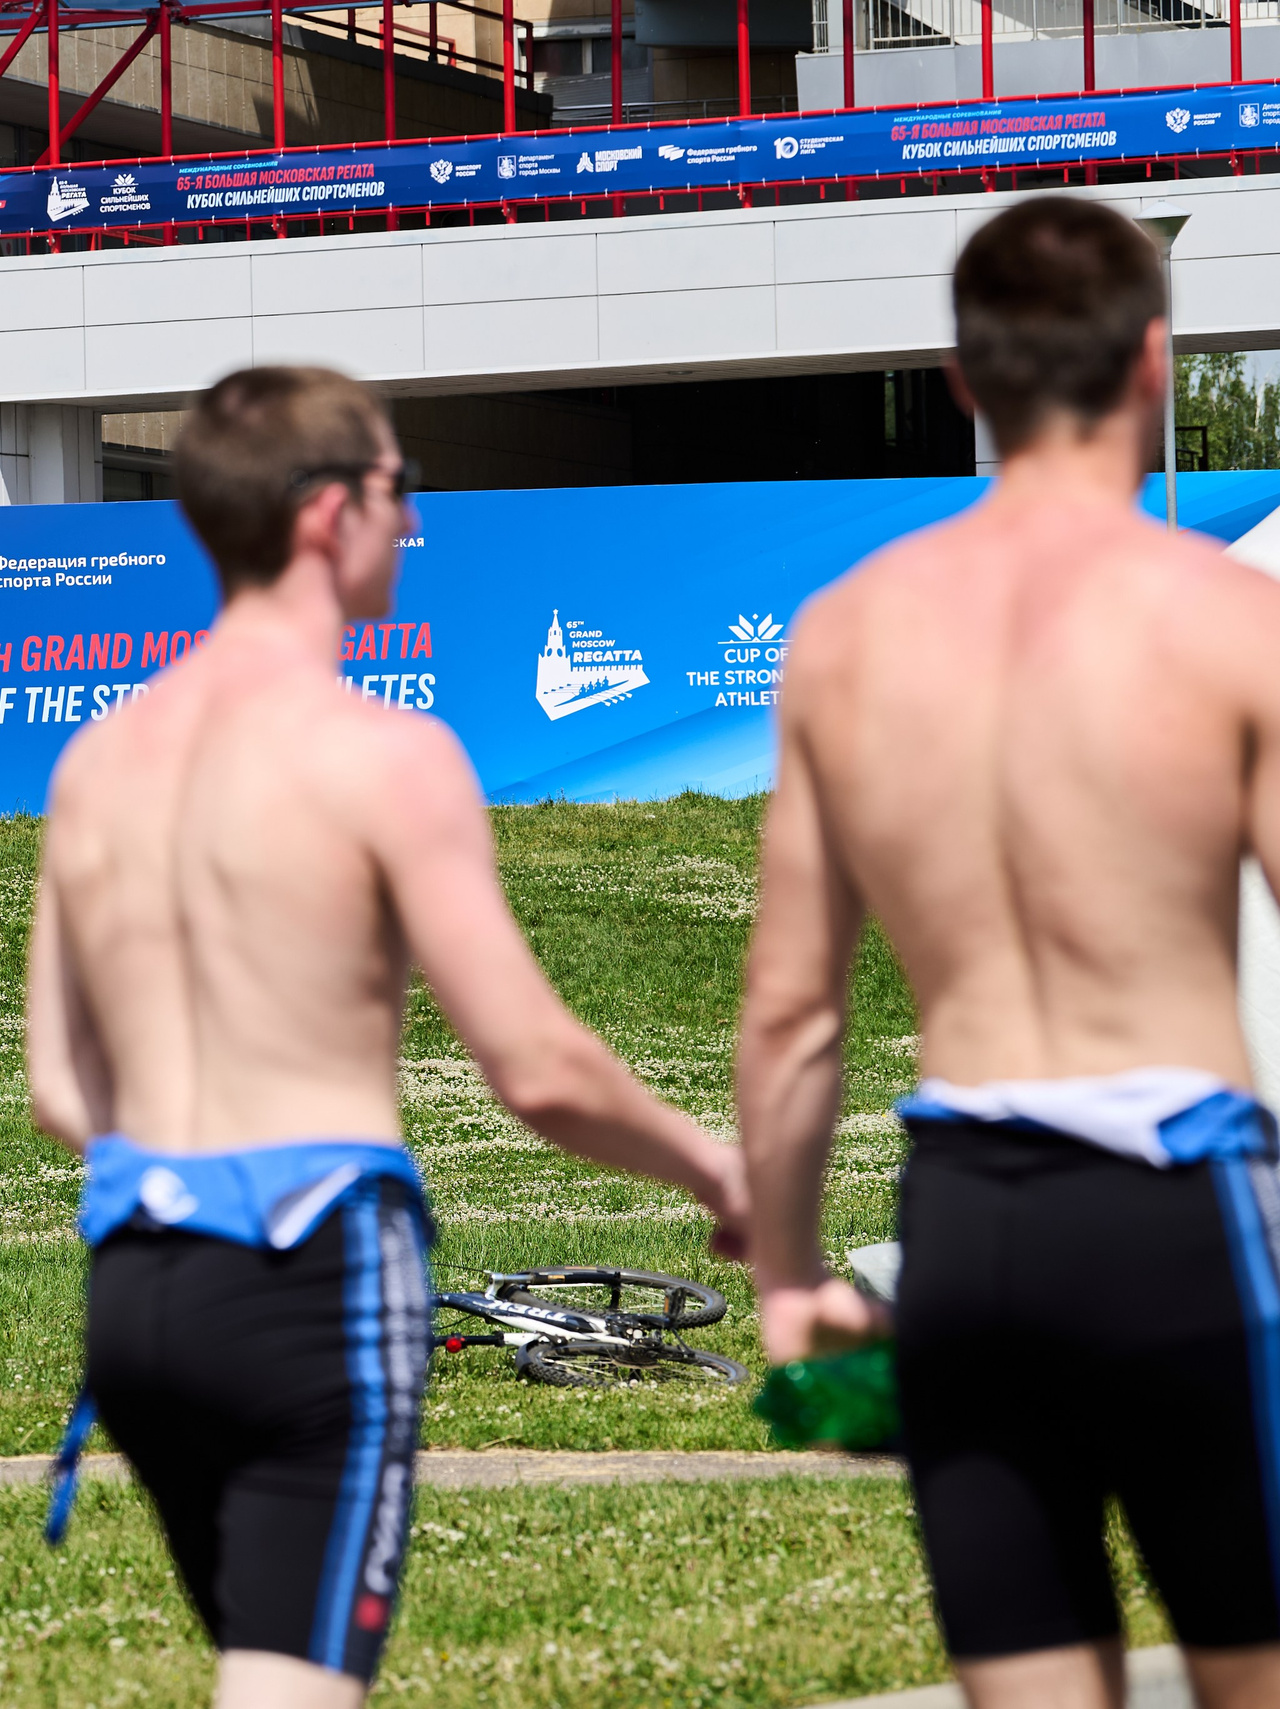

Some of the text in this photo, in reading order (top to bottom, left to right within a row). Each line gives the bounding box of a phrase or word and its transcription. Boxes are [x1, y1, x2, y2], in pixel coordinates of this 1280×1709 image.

[894, 110, 1002, 122] МЕЖДУНАРОДНЫЕ СОРЕВНОВАНИЯ
[891, 112, 1106, 141] 65-Я БОЛЬШАЯ МОСКОВСКАЯ РЕГАТА
[687, 145, 757, 156] Федерация гребного
[774, 136, 799, 159] 10
[902, 130, 1117, 160] КУБОК СИЛЬНЕЙШИХ СПОРТСМЕНОВ
[595, 146, 642, 161] МОСКОВСКИЙ
[687, 156, 711, 164] спорта
[179, 161, 278, 174] МЕЖДУНАРОДНЫЕ СОРЕВНОВАНИЯ
[595, 161, 618, 172] СПОРТ
[176, 164, 374, 190] 65-Я БОЛЬШАЯ МОСКОВСКАЯ РЕГАТА
[100, 194, 149, 204] СИЛЬНЕЙШИХ
[187, 182, 385, 209] КУБОК СИЛЬНЕЙШИХ СПОРТСМЕНОВ
[100, 203, 151, 213] СПОРТСМЕНОВ
[90, 552, 166, 570] гребного
[55, 572, 112, 586] России
[570, 630, 602, 638] GRAND
[21, 632, 133, 672] GRAND
[336, 622, 433, 661] GATTA
[572, 639, 616, 648] MOSCOW
[573, 650, 642, 662] REGATTA
[724, 648, 789, 664] CUP OF
[686, 669, 784, 686] THE STRON
[24, 685, 85, 724] THE
[715, 691, 782, 707] ATHLET
